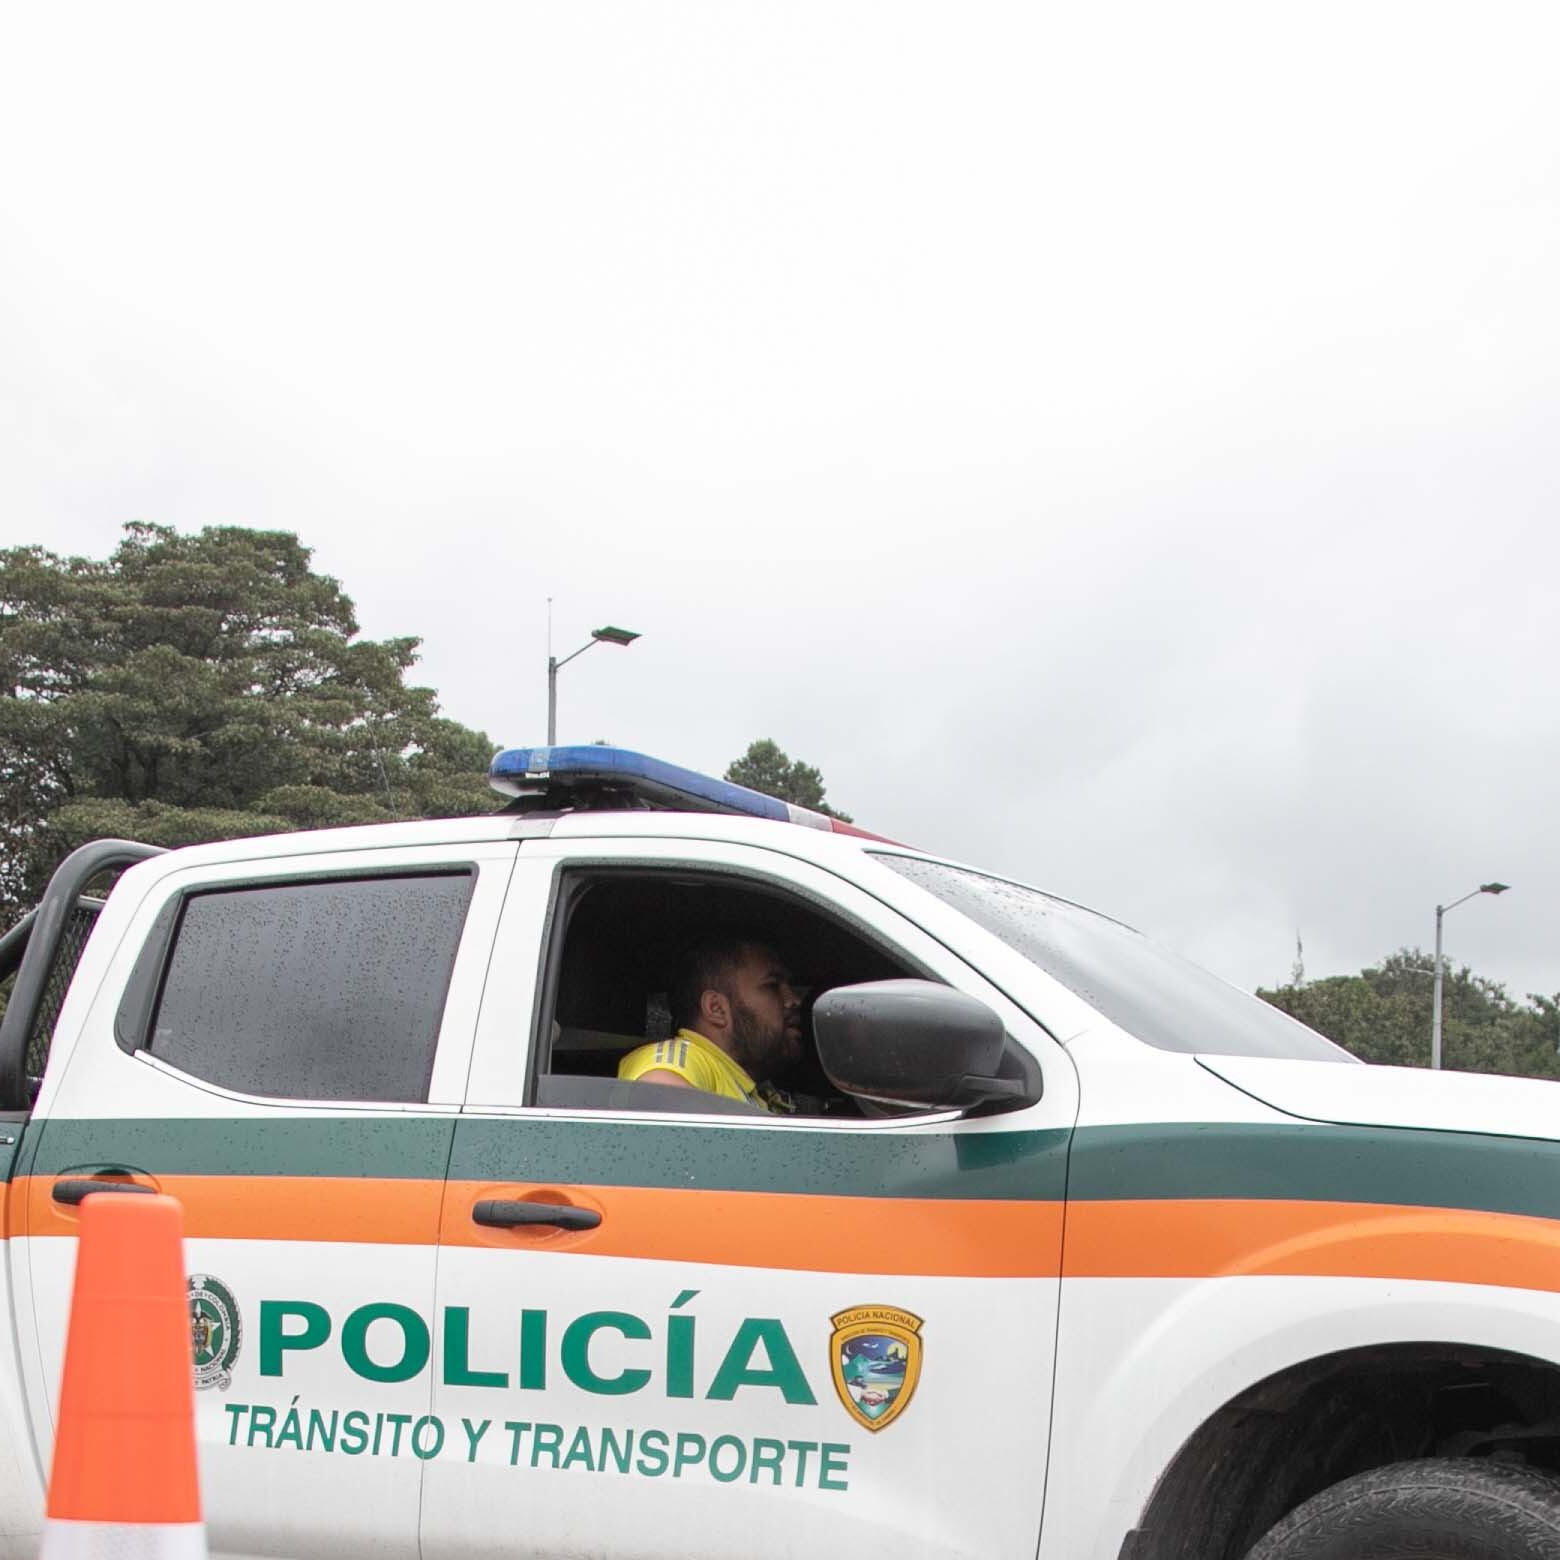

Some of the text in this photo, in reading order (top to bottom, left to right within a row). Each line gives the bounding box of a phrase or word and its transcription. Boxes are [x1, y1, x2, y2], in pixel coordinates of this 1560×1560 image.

[259, 1290, 818, 1405] POLICÍA
[872, 1311, 916, 1329] NACIONAL
[224, 1395, 851, 1491] TRÁNSITO Y TRANSPORTE
